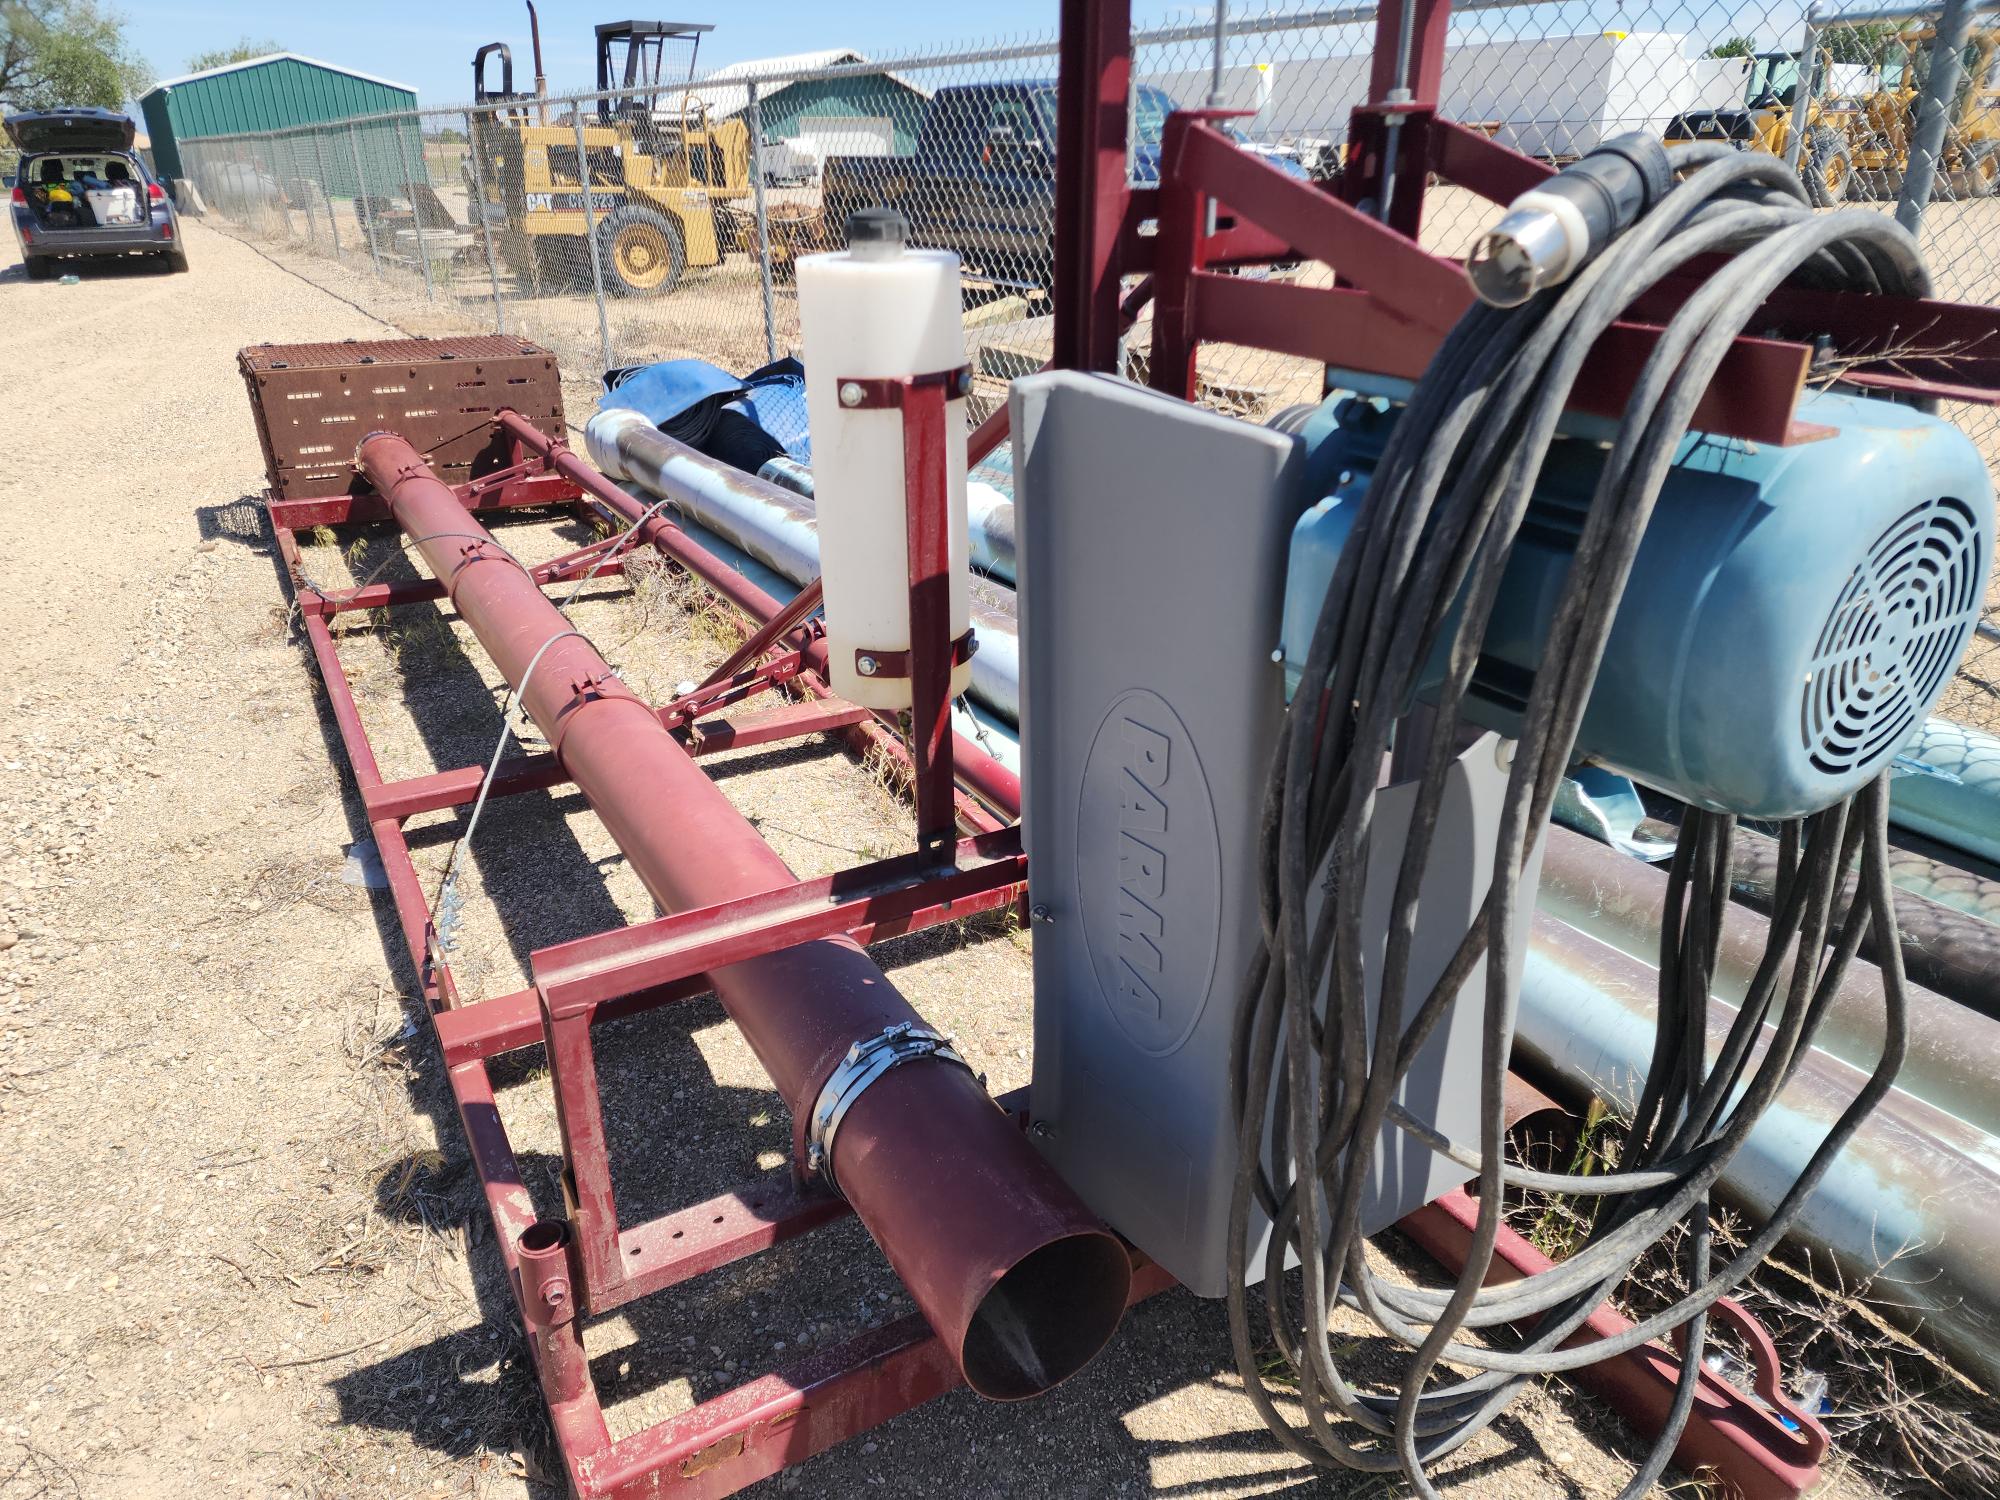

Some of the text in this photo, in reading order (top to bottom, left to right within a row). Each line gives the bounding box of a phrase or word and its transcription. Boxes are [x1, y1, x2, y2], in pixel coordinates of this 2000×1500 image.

[1699, 120, 1716, 132] CAT
[526, 193, 552, 211] CAT
[1119, 717, 1171, 1021] PARMA
